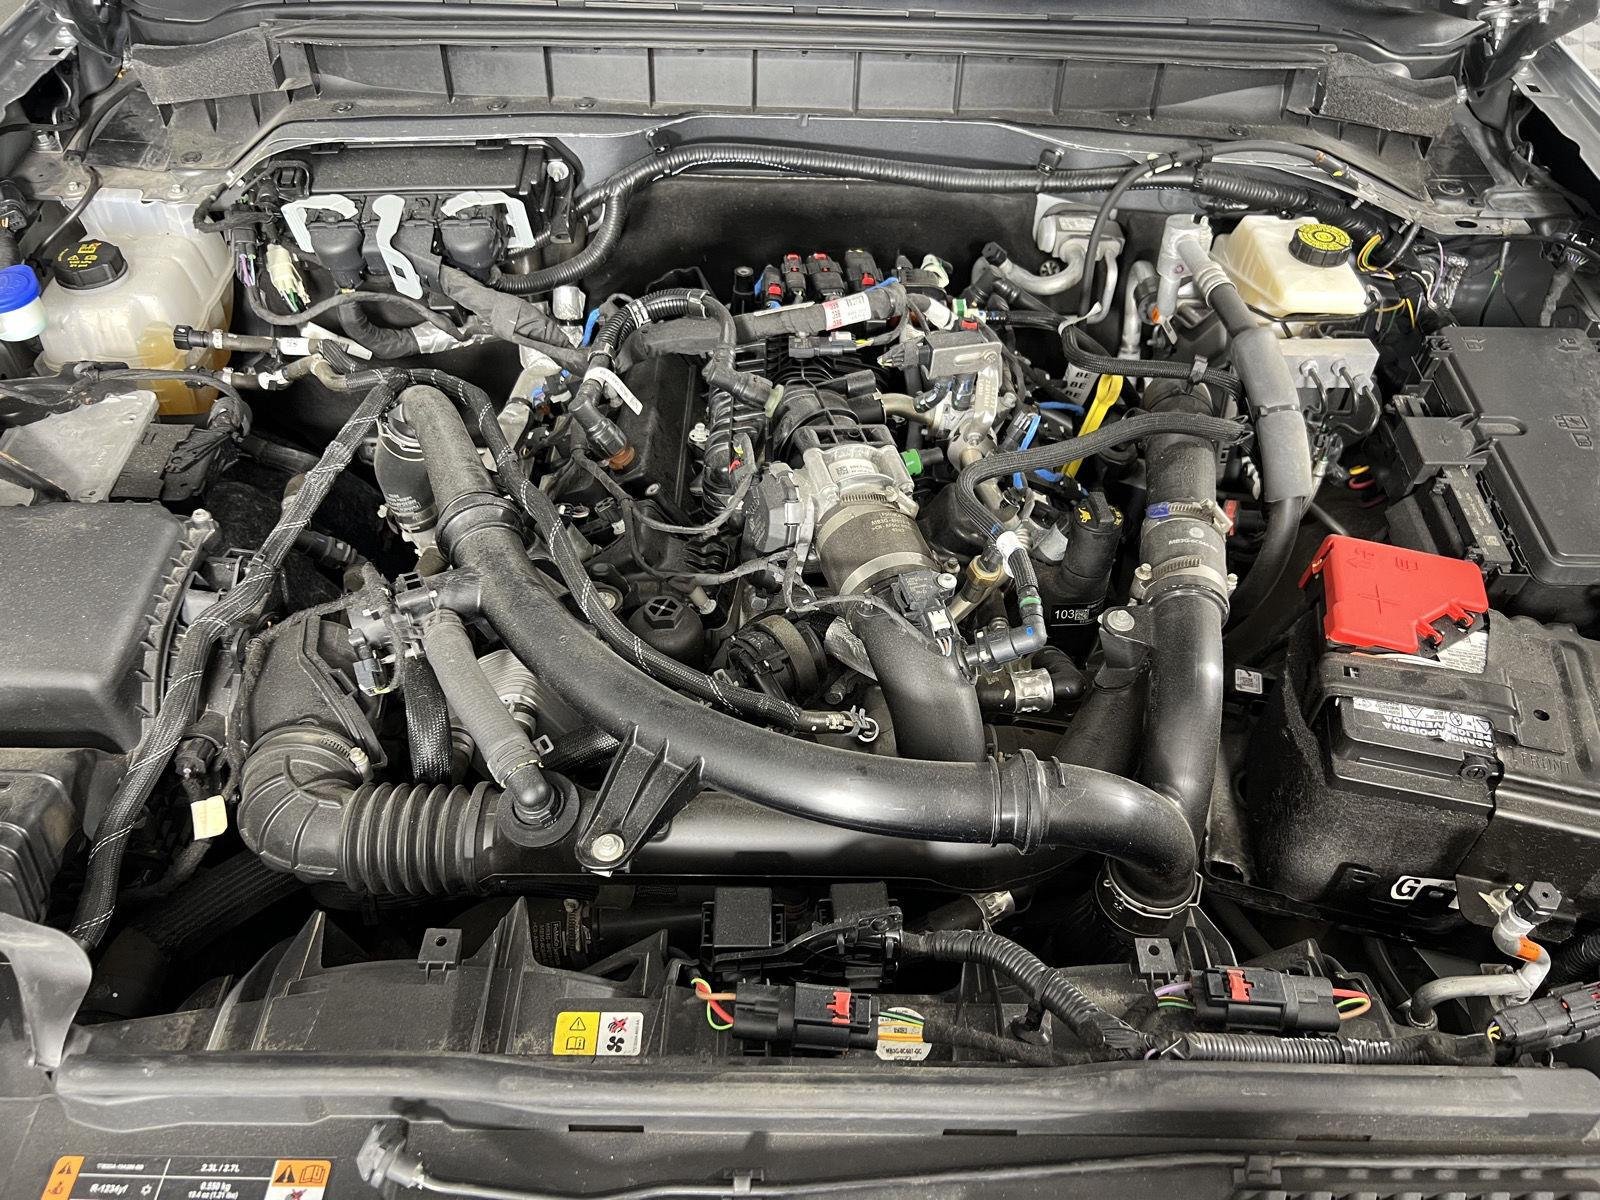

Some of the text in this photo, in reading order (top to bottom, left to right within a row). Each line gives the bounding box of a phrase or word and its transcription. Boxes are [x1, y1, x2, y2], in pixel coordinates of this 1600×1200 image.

[1070, 381, 1086, 390] BE
[1055, 609, 1075, 619] 103
[223, 1164, 240, 1173] 2.7L
[90, 1183, 129, 1195] R-1234yf
